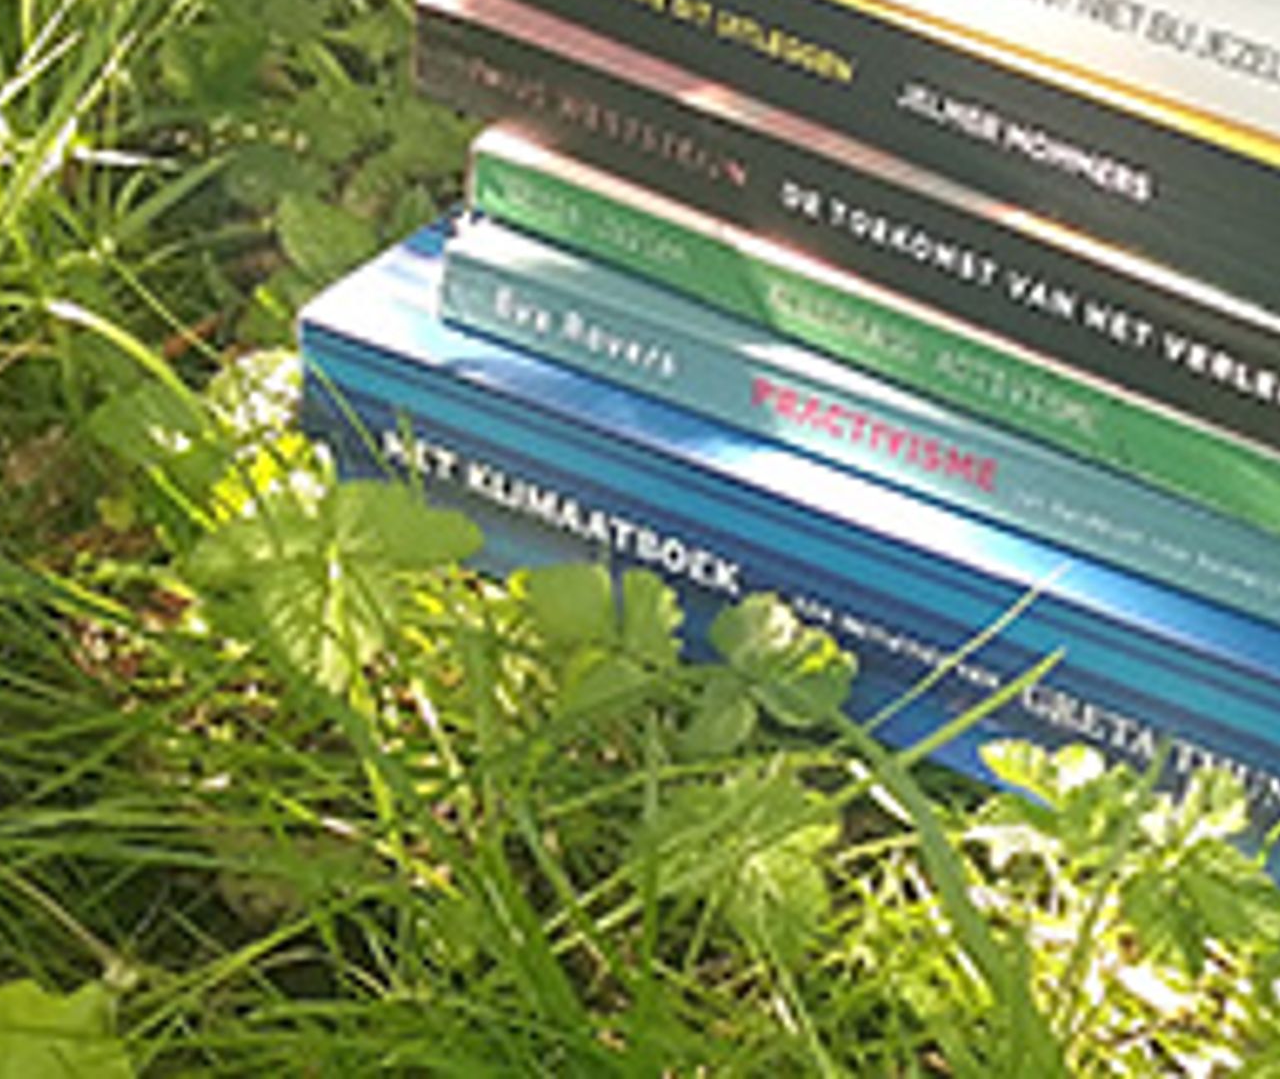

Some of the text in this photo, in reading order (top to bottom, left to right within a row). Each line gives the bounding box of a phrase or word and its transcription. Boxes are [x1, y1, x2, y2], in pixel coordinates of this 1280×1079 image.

[779, 179, 821, 215] DE
[827, 198, 999, 286] TOEKOMST
[1008, 269, 1074, 319] VAN
[1083, 301, 1152, 349] HET
[491, 285, 678, 377] Eva Rovers
[751, 374, 999, 495] PRACTIVISME
[466, 462, 744, 597] KLIMAATBOEK
[1021, 682, 1159, 762] GRETA
